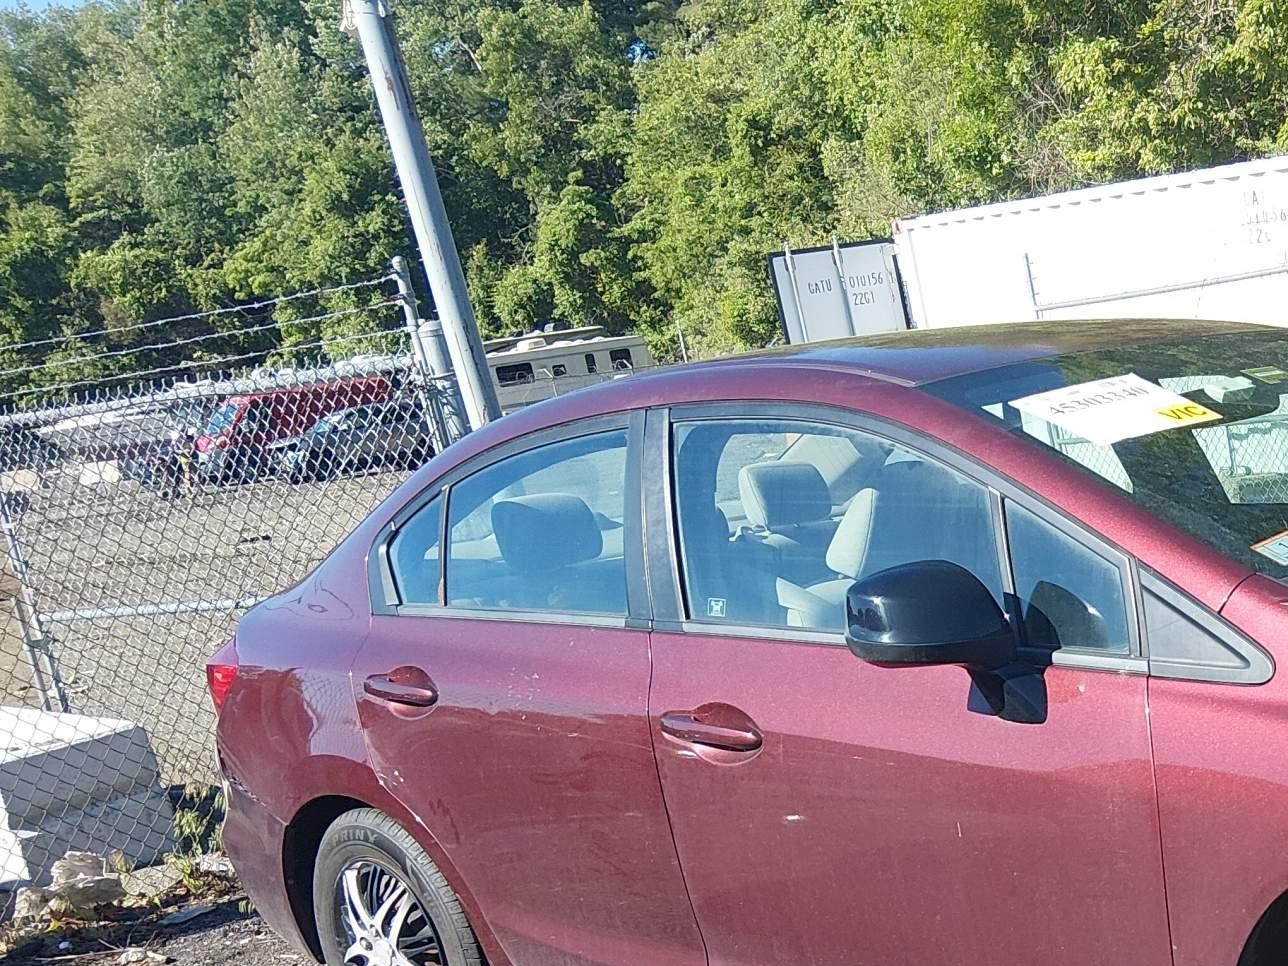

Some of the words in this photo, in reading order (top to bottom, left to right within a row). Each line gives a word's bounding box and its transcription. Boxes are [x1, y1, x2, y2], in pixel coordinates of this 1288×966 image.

[808, 279, 832, 295] GATU
[852, 291, 875, 306] 22G1
[1158, 406, 1207, 420] VIC
